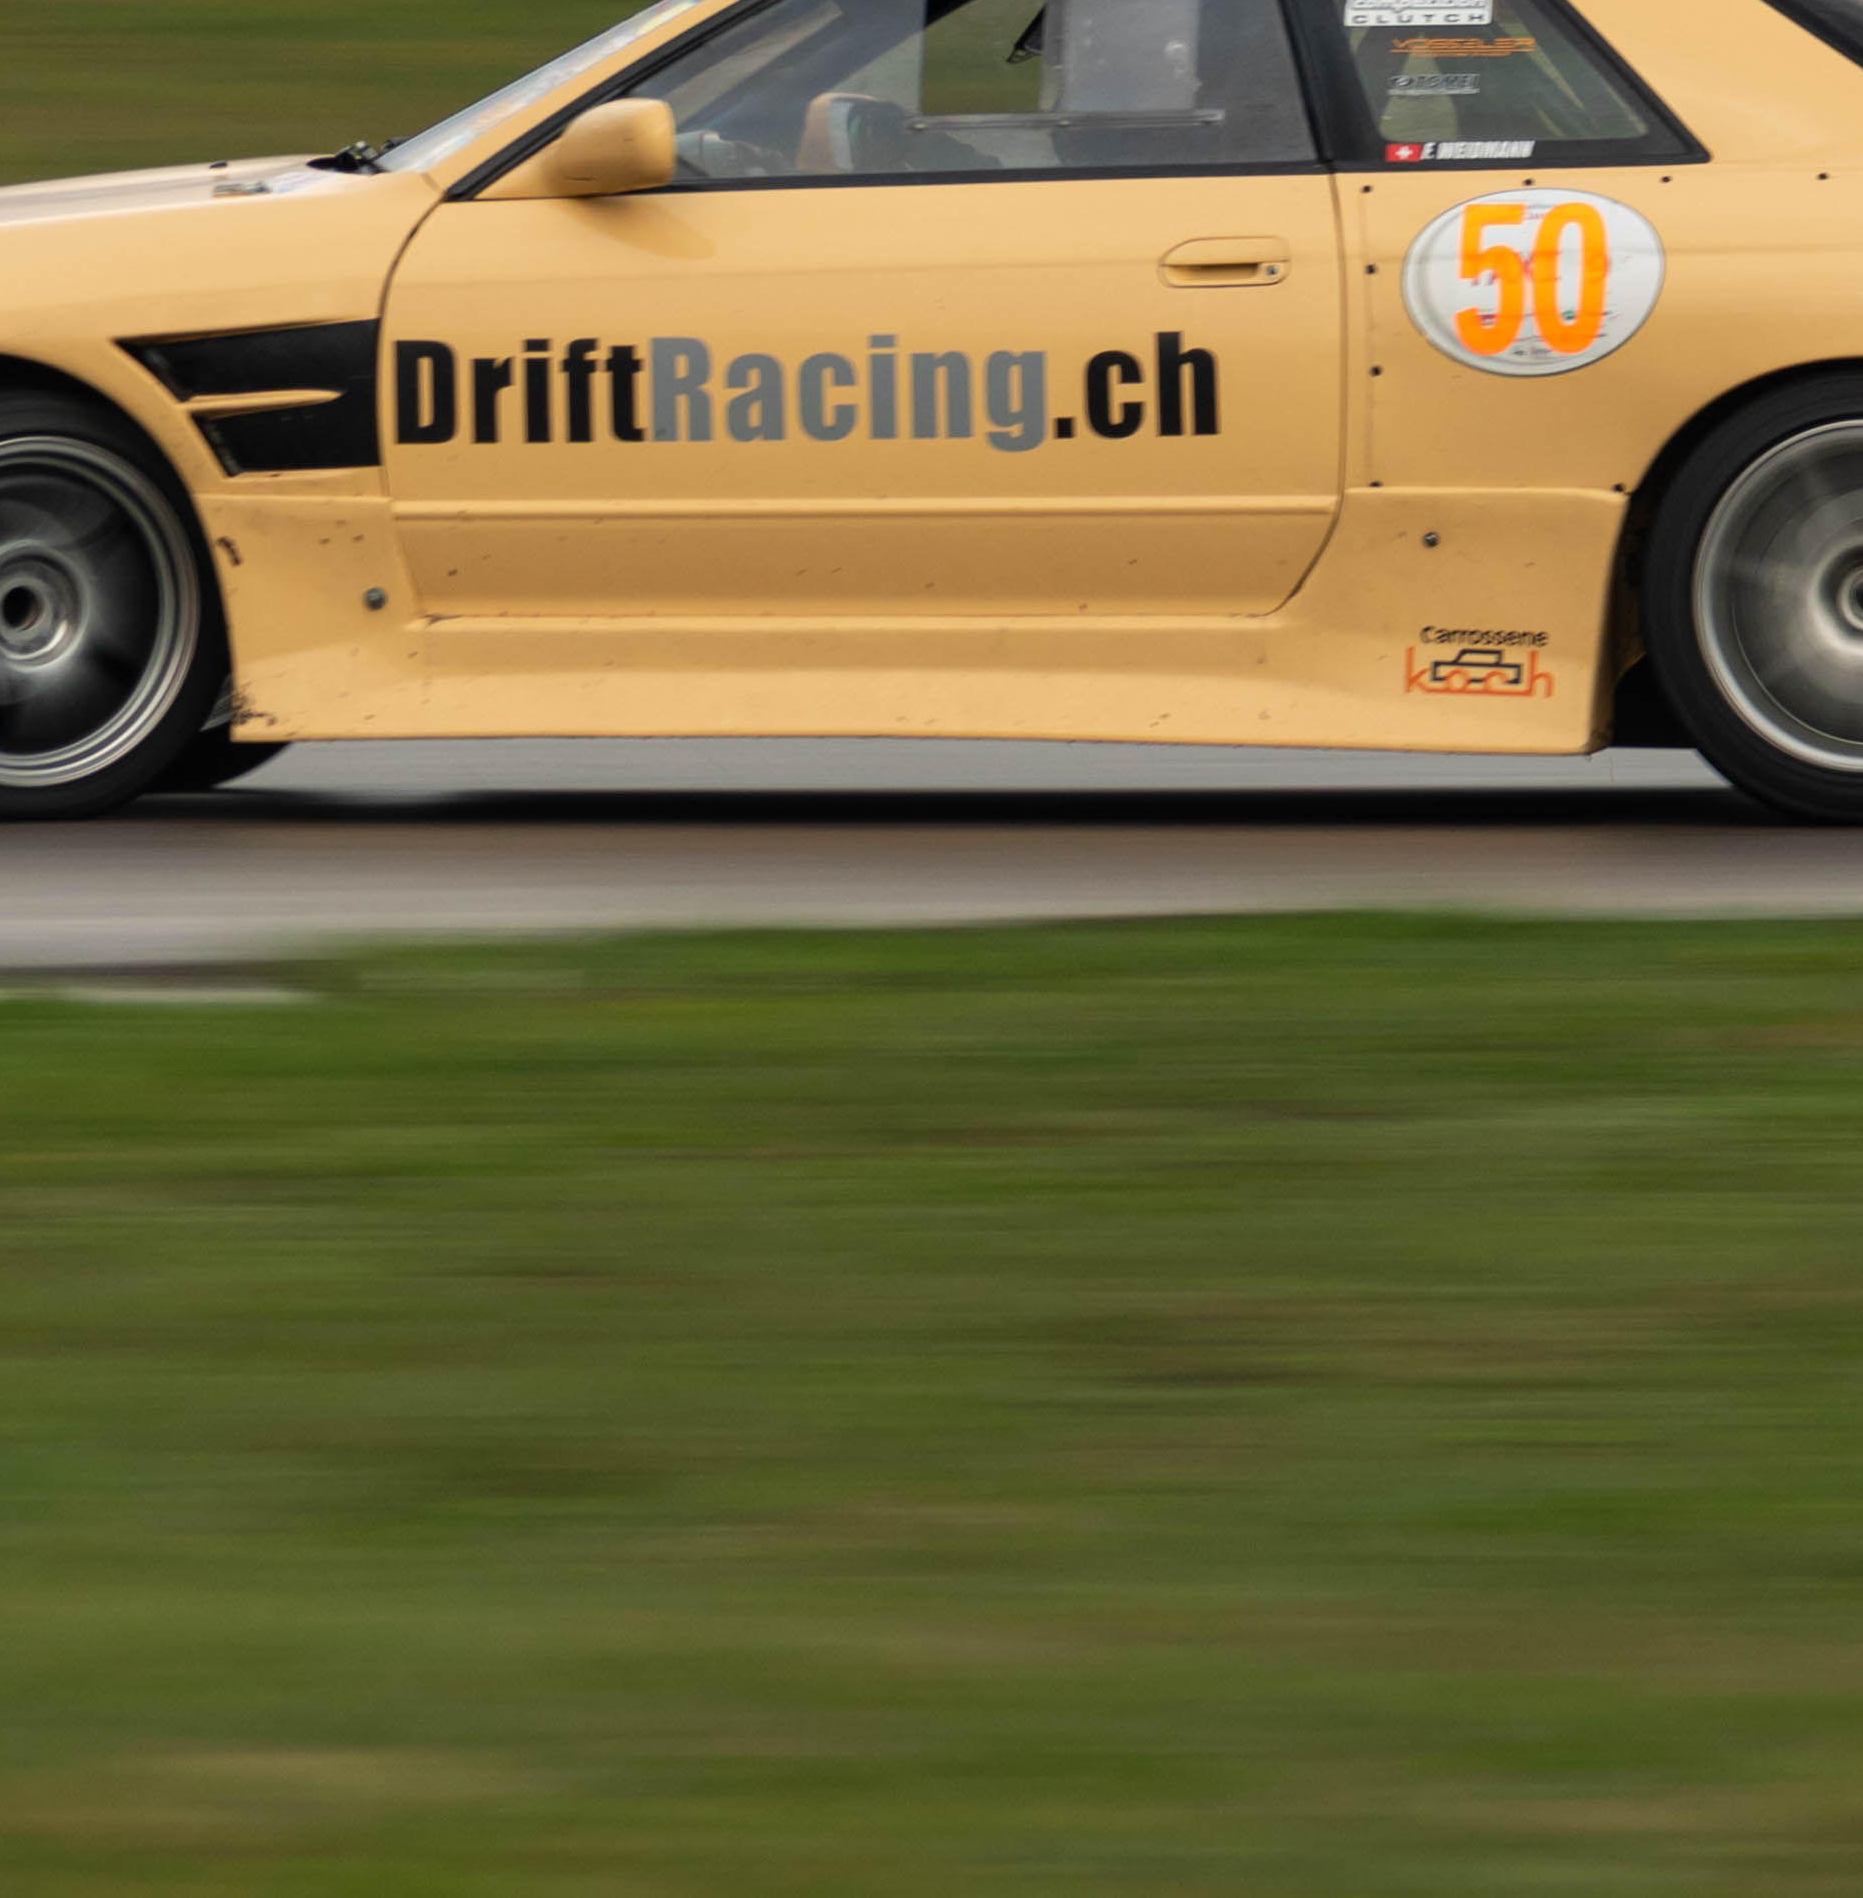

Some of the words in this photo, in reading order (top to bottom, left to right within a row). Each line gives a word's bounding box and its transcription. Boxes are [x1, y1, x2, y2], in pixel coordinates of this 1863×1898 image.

[1352, 13, 1484, 24] CLUTCH
[1453, 201, 1610, 356] 50
[393, 331, 1220, 452] DriftRacing.ch
